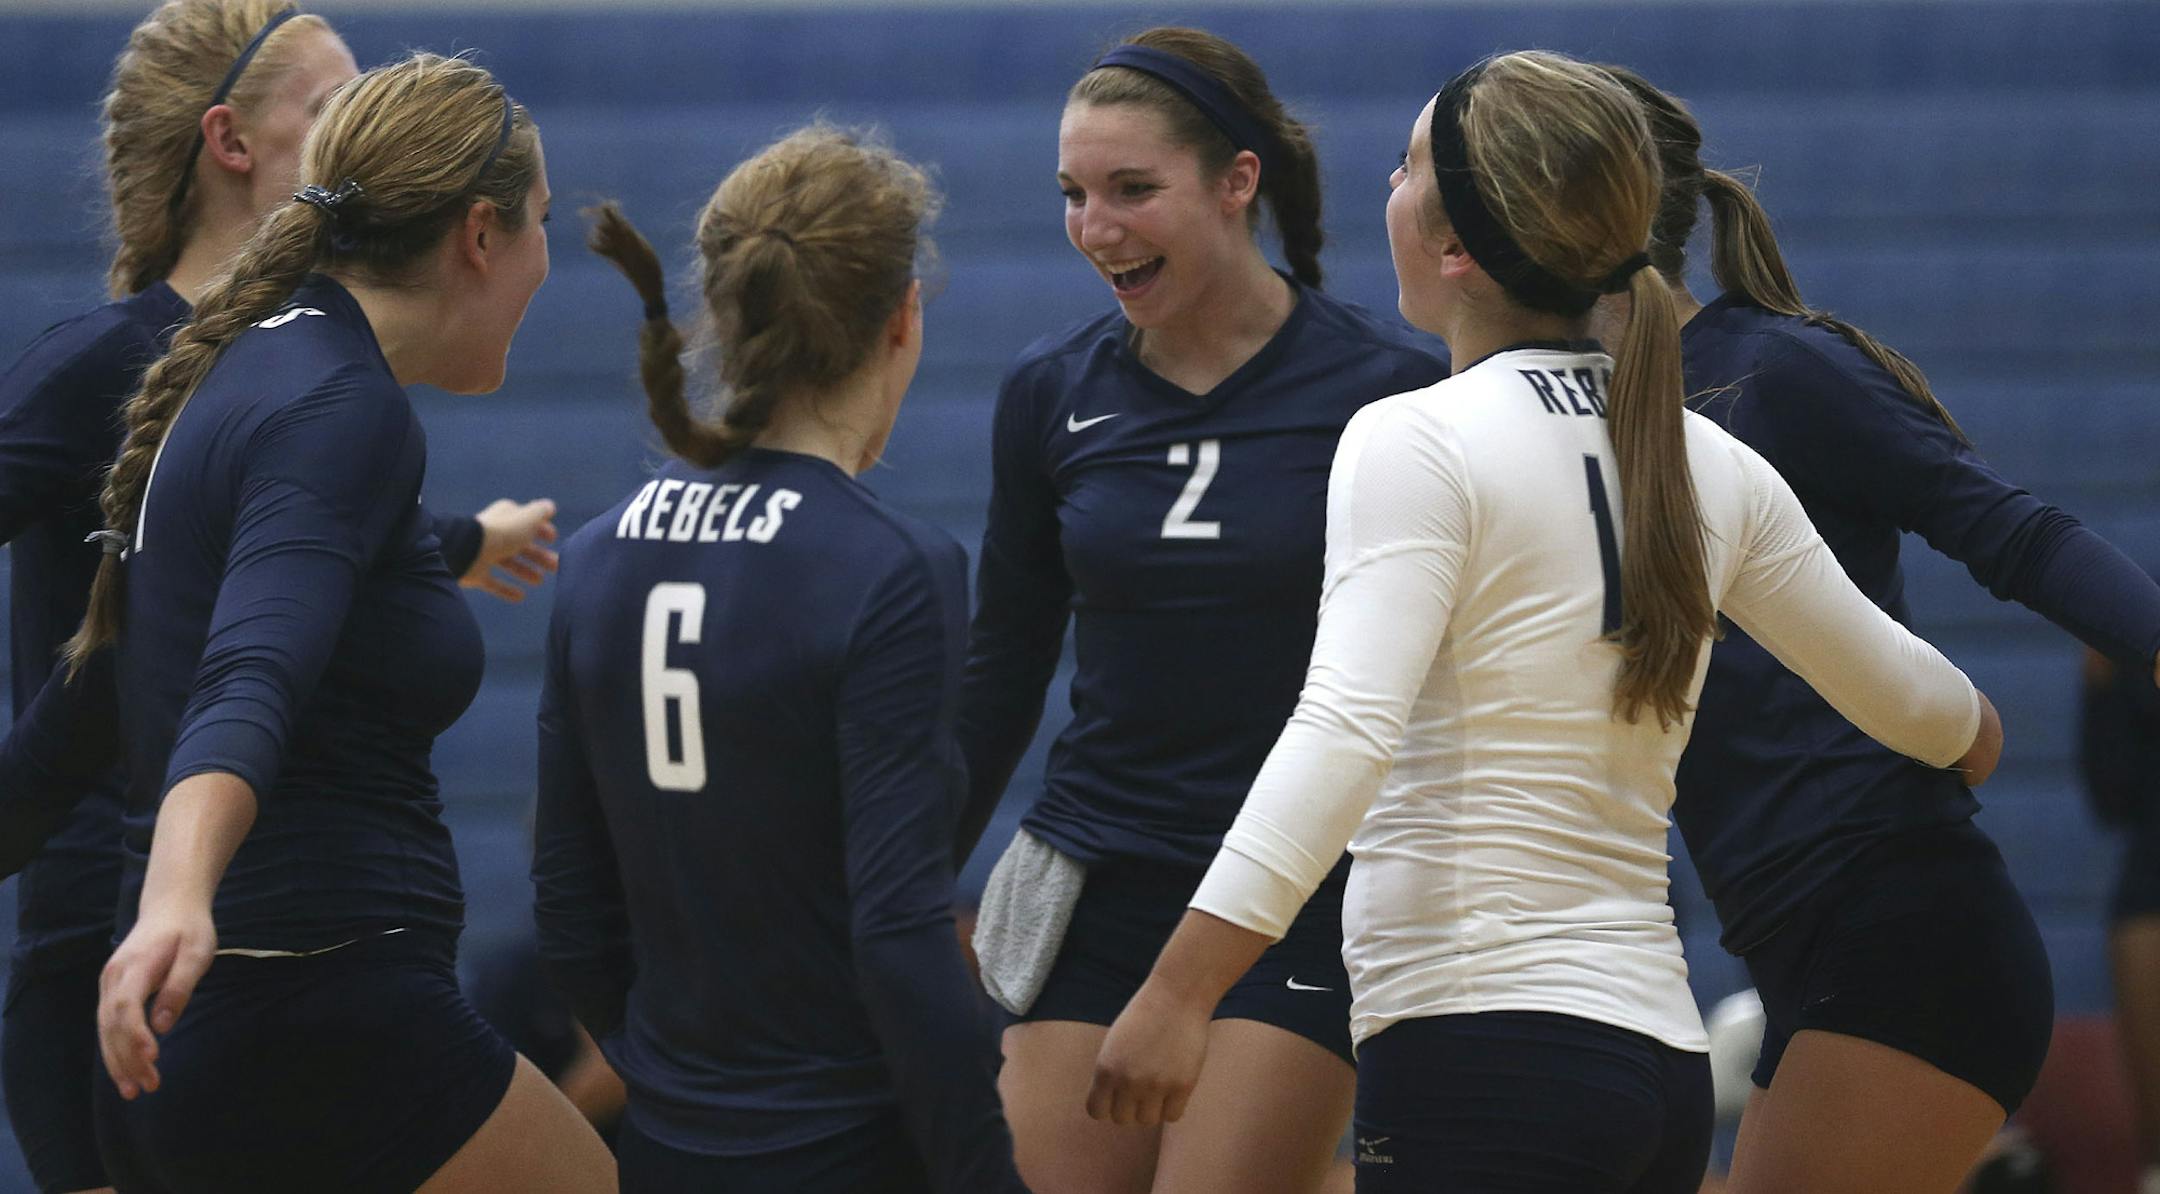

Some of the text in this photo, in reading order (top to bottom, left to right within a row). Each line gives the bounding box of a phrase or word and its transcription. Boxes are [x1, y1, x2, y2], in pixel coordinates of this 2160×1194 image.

[616, 479, 803, 543] REBELS
[1161, 439, 1221, 539] 2
[641, 581, 707, 792] 6
